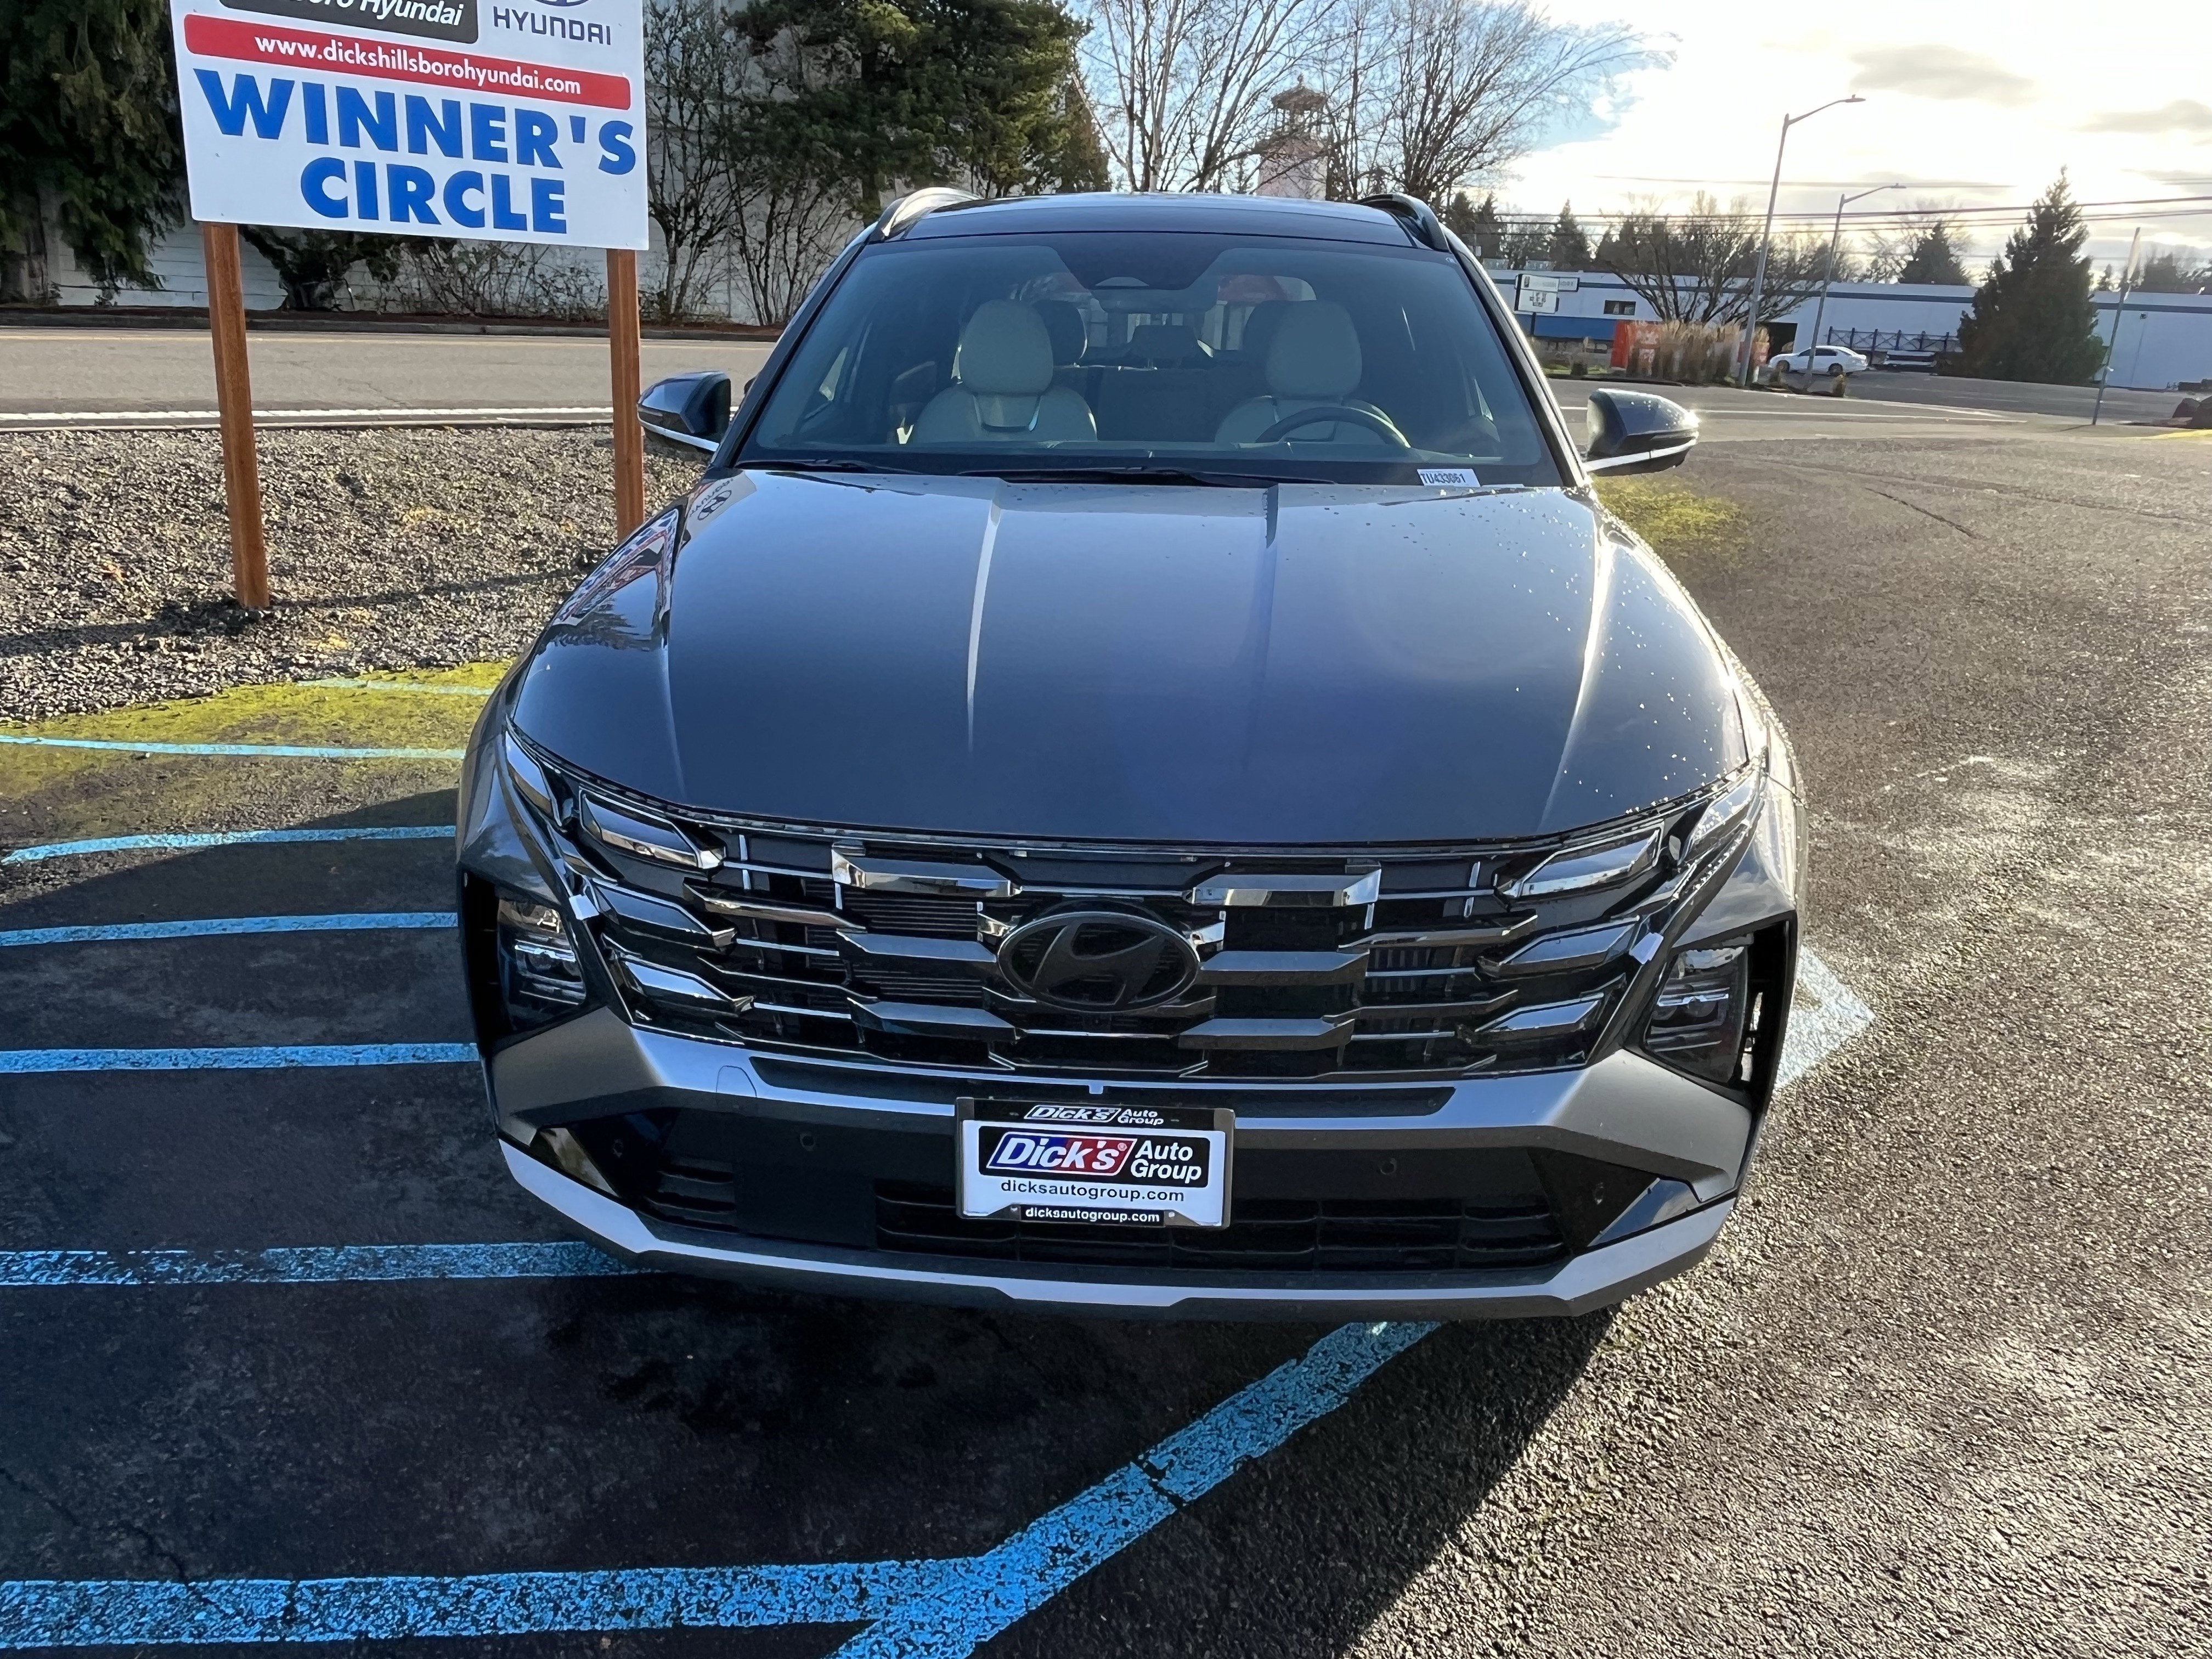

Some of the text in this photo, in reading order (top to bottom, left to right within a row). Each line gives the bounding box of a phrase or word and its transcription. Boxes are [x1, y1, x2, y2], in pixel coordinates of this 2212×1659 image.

[359, 0, 464, 26] Hyundai
[493, 5, 611, 46] HYUNDAI
[254, 35, 582, 94] www.dickshillsborohyundai.com
[194, 68, 636, 175] WINNER'S
[300, 156, 567, 234] CIRCLE
[1031, 1107, 1110, 1120] Dick's
[1117, 1115, 1164, 1126] Group
[1121, 1108, 1158, 1118] Auto
[996, 1137, 1120, 1170] Dick's
[1135, 1140, 1193, 1161] Auto
[1130, 1159, 1201, 1184] Group
[1001, 1180, 1184, 1201] dicksautogroup.com
[1025, 1207, 1160, 1223] dicksautogroup.com
